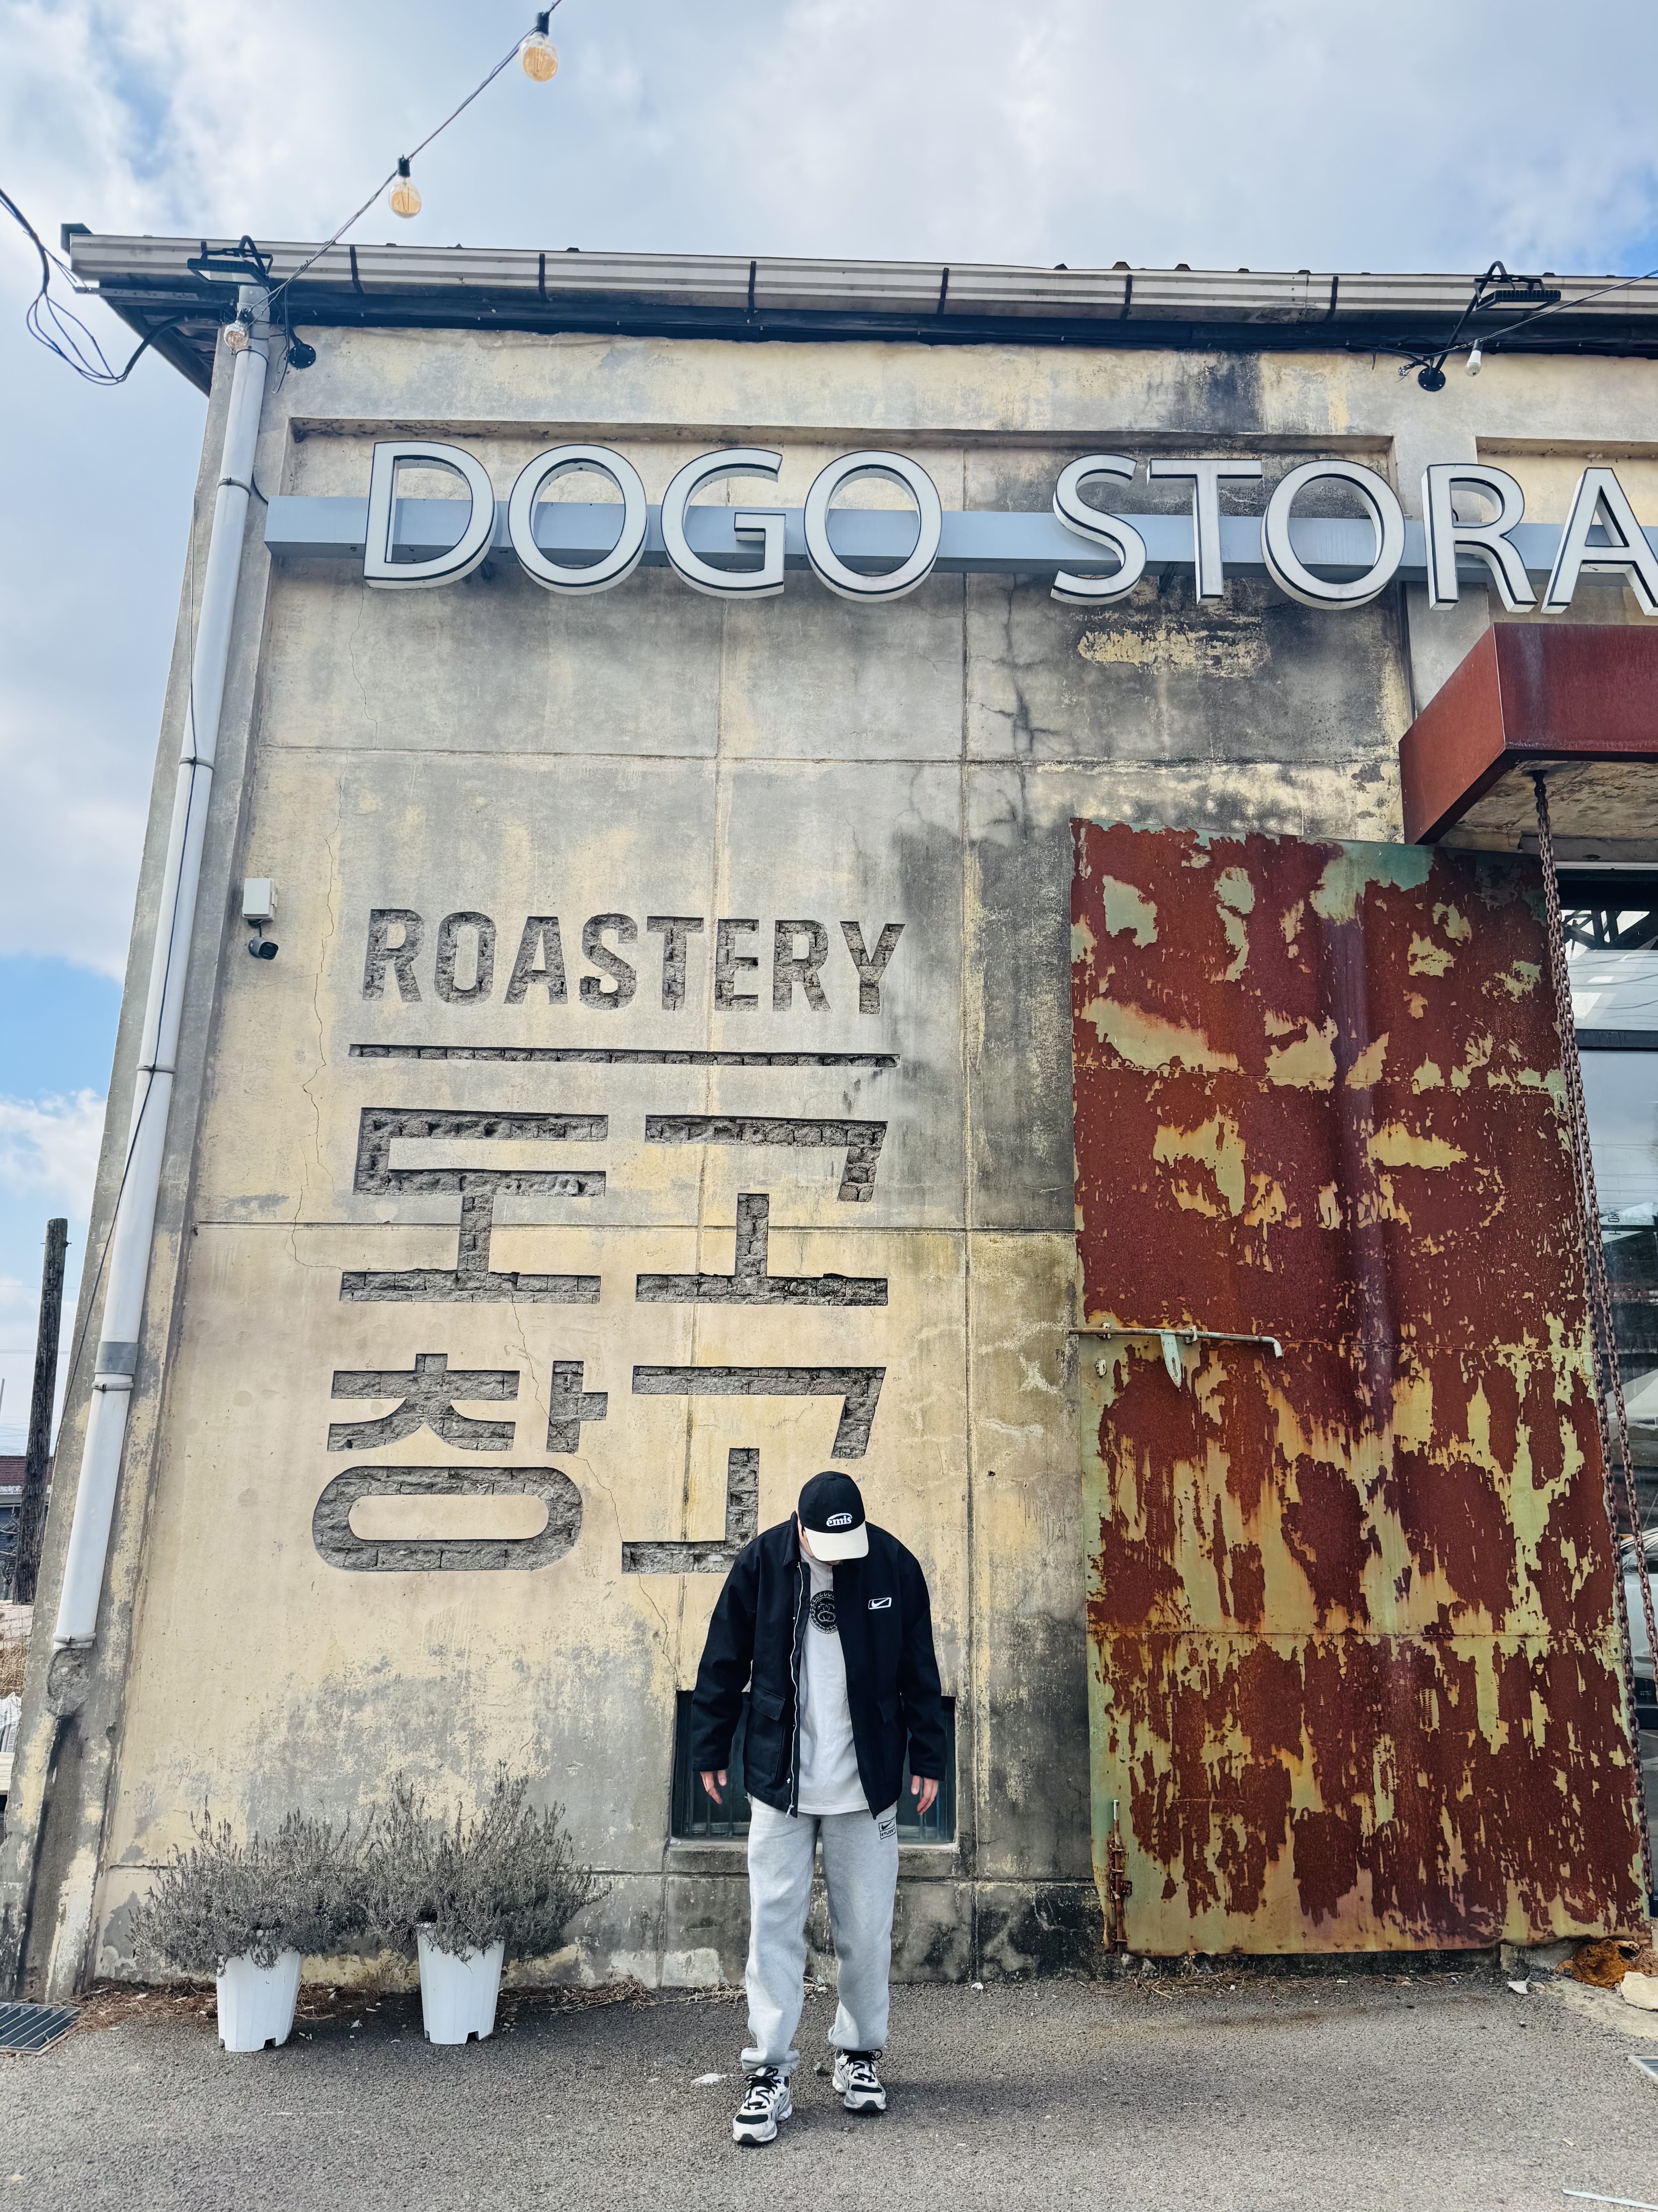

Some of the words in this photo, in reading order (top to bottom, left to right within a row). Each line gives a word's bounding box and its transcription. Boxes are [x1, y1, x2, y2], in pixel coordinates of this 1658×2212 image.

[363, 440, 943, 602] DOGO
[1050, 452, 1658, 615] STORA
[362, 908, 907, 1015] ROASTERY
[339, 1107, 889, 1307] 도고
[312, 1352, 888, 1575] 창고
[826, 1515, 852, 1527] emis
